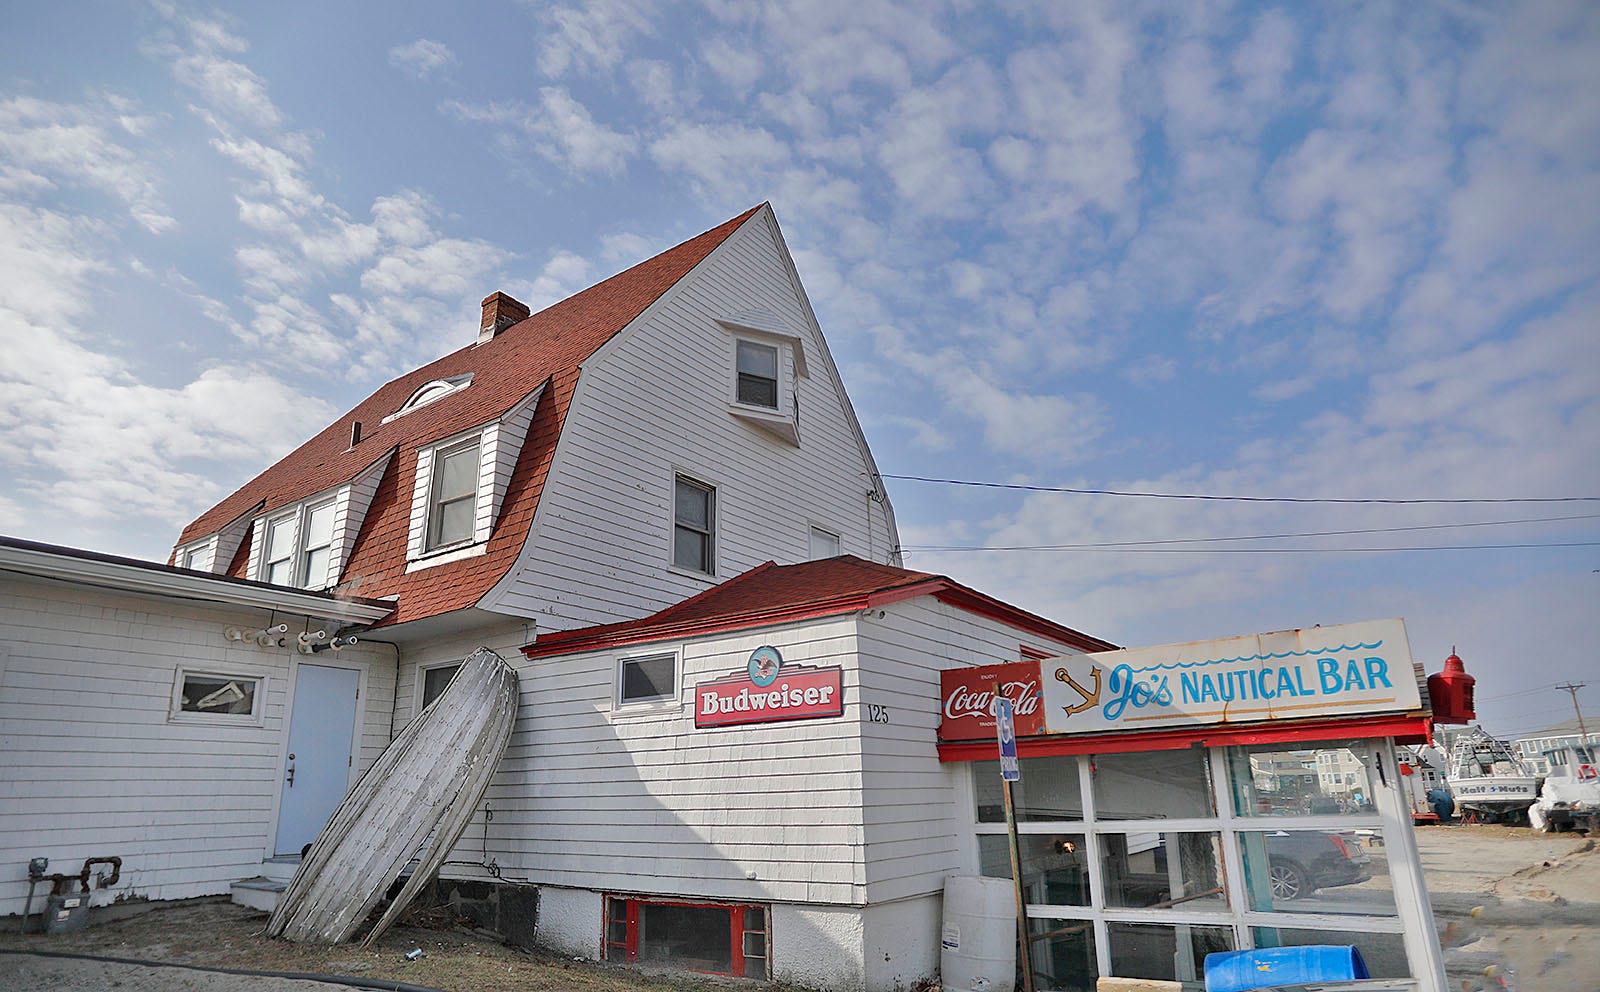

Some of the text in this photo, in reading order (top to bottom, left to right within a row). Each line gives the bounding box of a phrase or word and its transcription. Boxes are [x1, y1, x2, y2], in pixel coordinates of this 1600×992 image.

[700, 683, 834, 716] Budweiser
[1103, 656, 1393, 721] Jo's NAUTICAL BAR
[867, 703, 889, 724] 125
